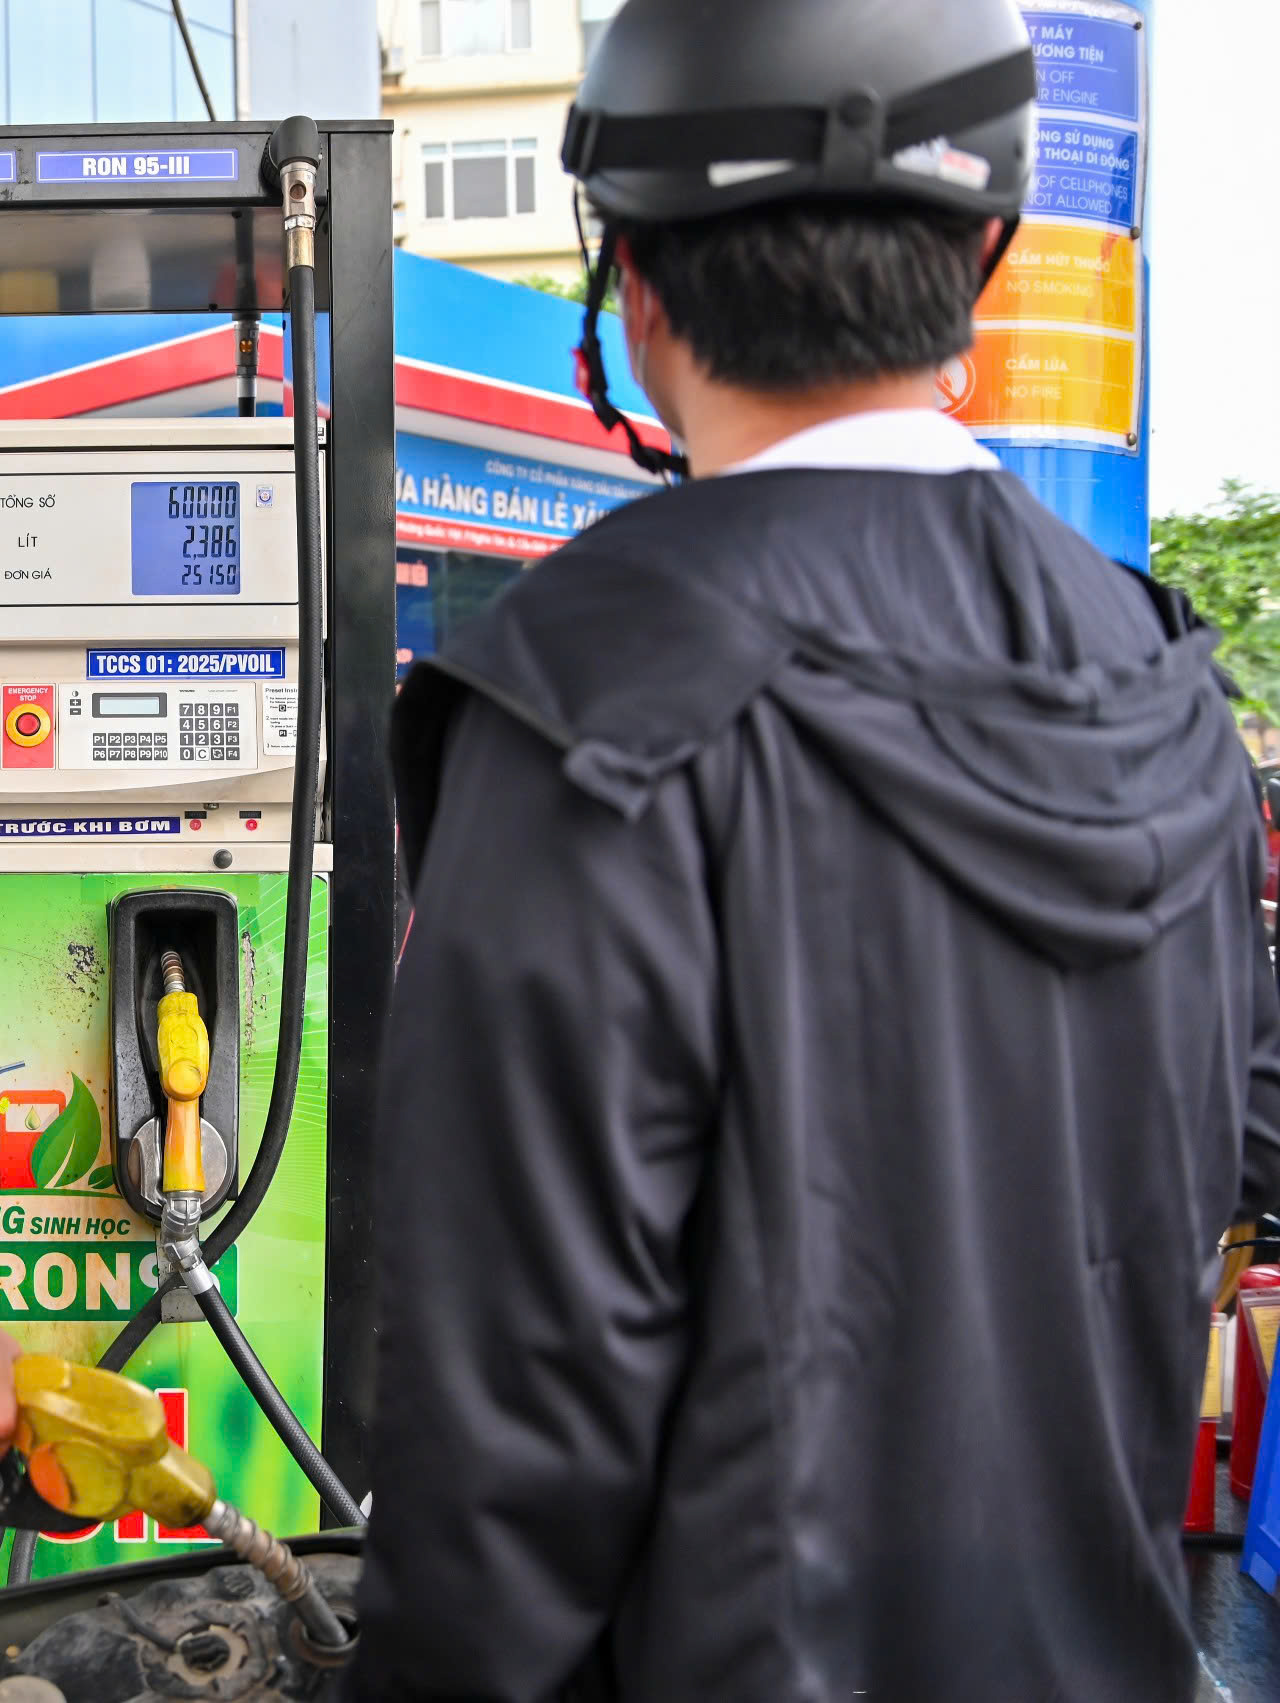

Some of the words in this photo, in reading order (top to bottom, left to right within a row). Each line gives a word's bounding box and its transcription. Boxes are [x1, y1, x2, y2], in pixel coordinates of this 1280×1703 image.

[1041, 24, 1073, 40] MÁY
[1032, 42, 1075, 59] ƯƠNG
[1079, 45, 1104, 65] TIỆN
[1049, 70, 1074, 83] OFF
[1053, 88, 1099, 105] ENGINE
[1083, 134, 1114, 151] DỤNG
[1044, 147, 1083, 165] THOẠI
[1086, 152, 1098, 164] DI
[82, 156, 127, 176] RON
[133, 156, 190, 176] 95-III
[1060, 176, 1128, 200] CELLPHONES
[1056, 194, 1112, 214] ALLOWED
[1007, 280, 1030, 294] NO
[1033, 280, 1094, 297] SMOKING
[1005, 385, 1030, 399] NO
[1032, 385, 1062, 400] FIRE
[0, 493, 34, 508] TỔNG
[39, 493, 56, 508] SỐ
[169, 486, 237, 519] 60000
[423, 473, 488, 516] HÀNG
[493, 486, 538, 524] BÁN
[18, 533, 38, 548] LÍT
[183, 525, 237, 560] 2,386
[4, 569, 29, 580] ĐƠN
[31, 567, 53, 580] GIÁ
[96, 655, 141, 674] TCCS
[146, 655, 172, 673] 01:
[178, 653, 275, 673] 2025/PVOIL
[8, 687, 49, 695] EMERGENCY
[183, 705, 189, 714] 7
[198, 705, 205, 715] 8
[213, 705, 220, 714] 9
[228, 706, 236, 714] F1
[183, 720, 190, 729] 4
[199, 720, 205, 729] 5
[213, 720, 220, 729] 6
[94, 736, 105, 744] P1
[109, 736, 120, 744] P2
[124, 736, 136, 744] P3
[140, 736, 151, 744] P4
[154, 736, 167, 744] P5
[184, 735, 188, 744] 1
[199, 735, 205, 744] 2
[214, 734, 220, 744] 3
[94, 750, 105, 759] P6
[109, 750, 120, 759] P7
[124, 750, 136, 759] P8
[140, 750, 151, 759] P9
[154, 750, 167, 759] P10
[183, 749, 190, 759] 0
[198, 750, 206, 759] C
[73, 821, 113, 833] KHI
[118, 819, 171, 832] BƠM
[30, 1216, 79, 1235] SINH
[85, 1218, 131, 1240] HỌC
